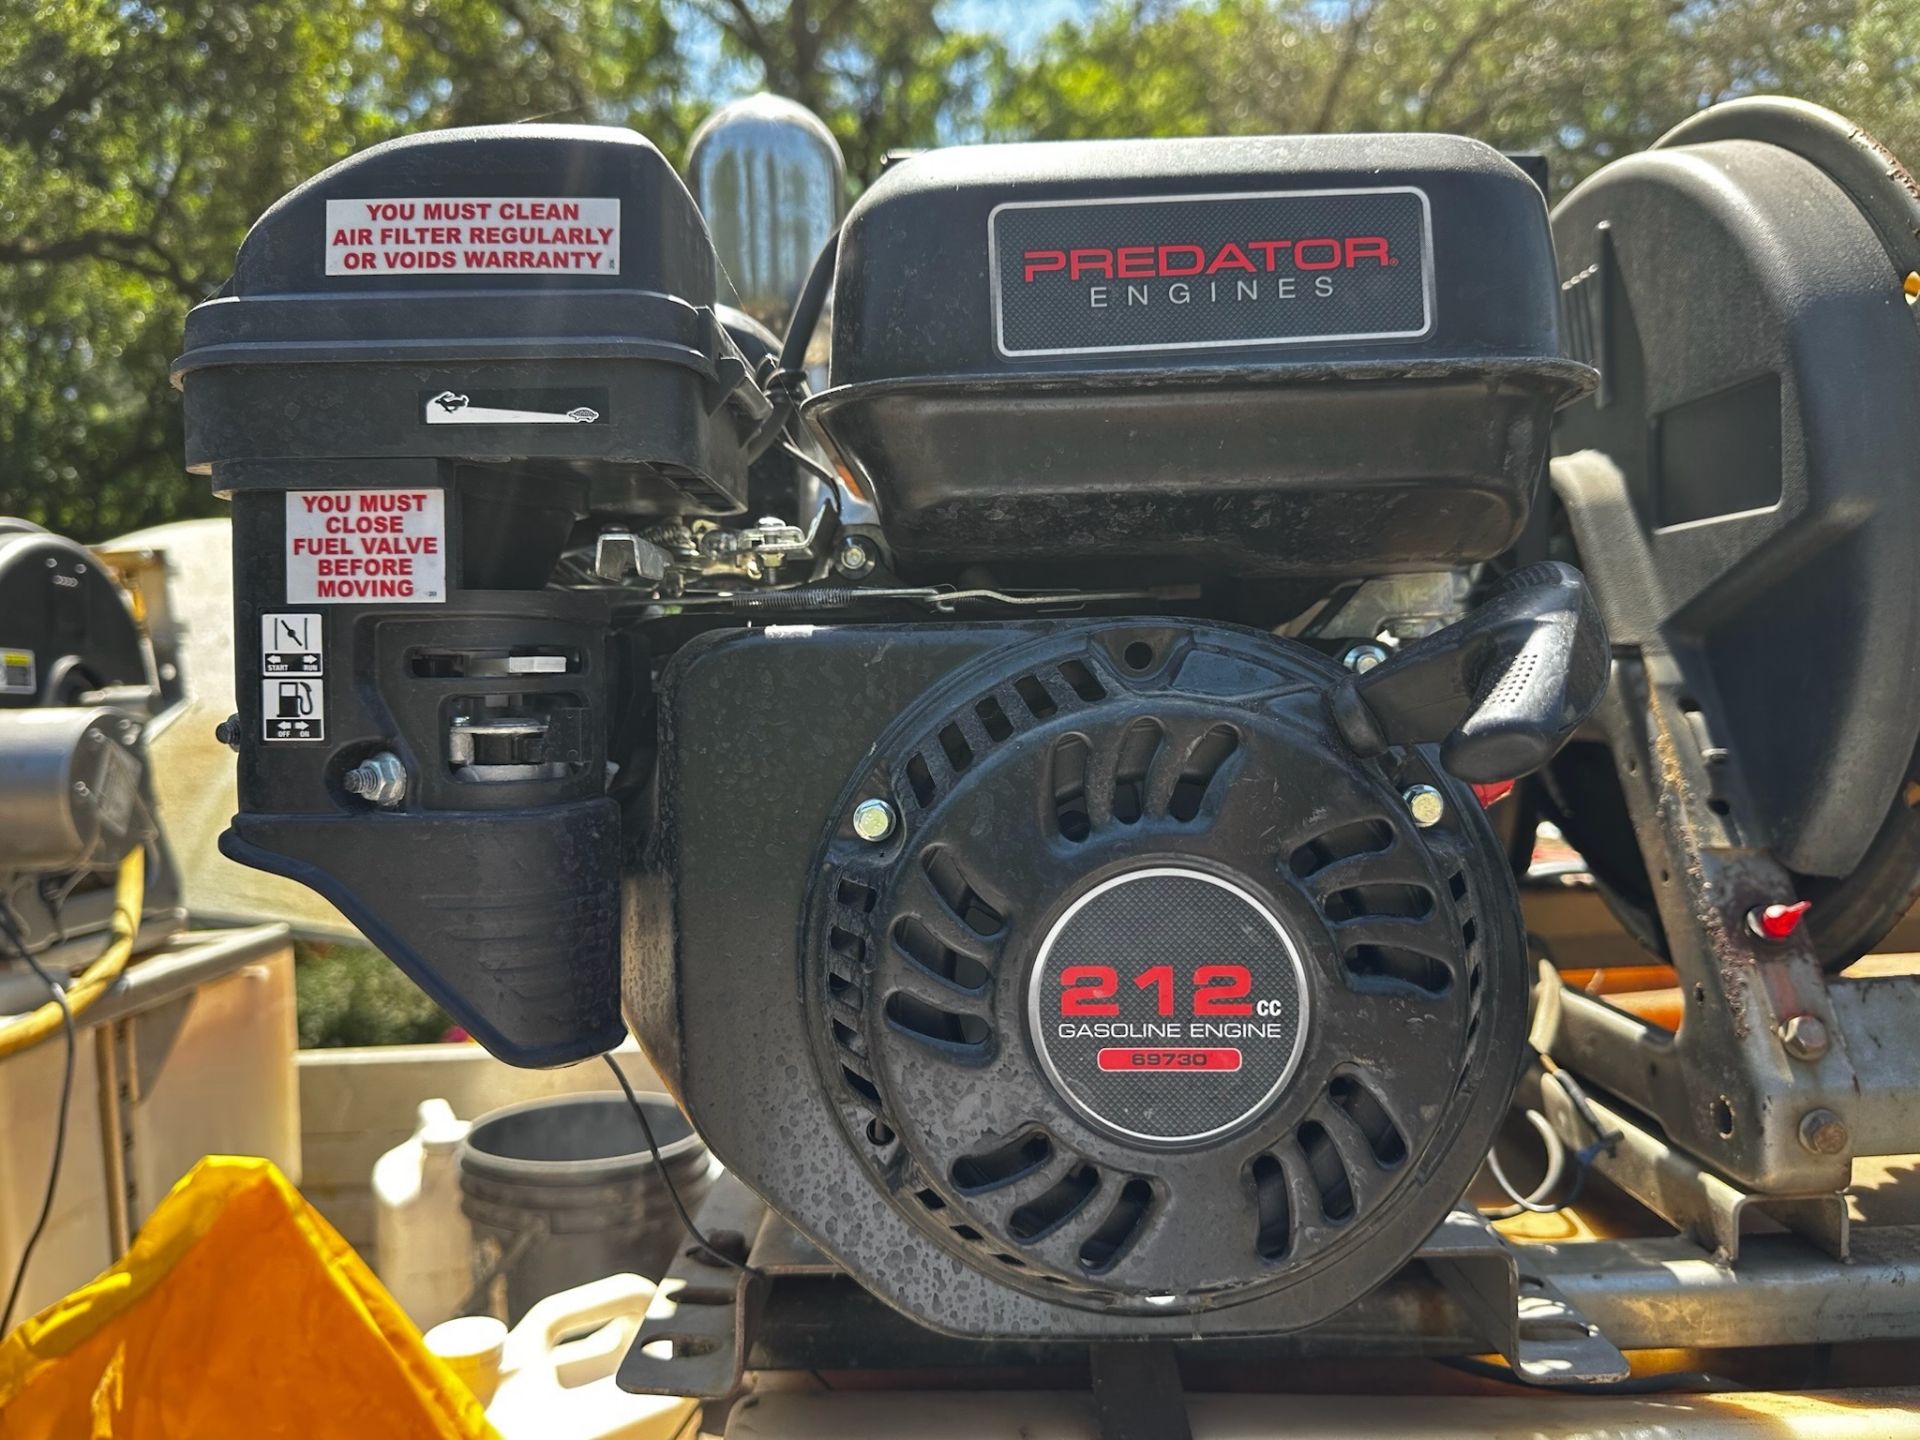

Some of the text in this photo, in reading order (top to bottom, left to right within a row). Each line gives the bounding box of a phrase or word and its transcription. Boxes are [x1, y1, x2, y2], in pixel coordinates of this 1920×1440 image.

[366, 203, 579, 221] YOU MUST CLEAN
[332, 227, 614, 246] AIR FILTER REGULARLY
[343, 252, 377, 270] OR
[383, 251, 457, 269] VOIDS
[464, 251, 603, 269] WARRANTY
[1089, 276, 1335, 308] ENGINES
[302, 494, 427, 513] YOU MUST
[325, 516, 404, 534] CLOSE
[293, 537, 438, 555] FUEL VALVE
[318, 558, 413, 576] BEFORE
[317, 579, 414, 597] MOVING
[1058, 963, 1253, 1017] 212
[1058, 1022, 1282, 1039] GASOLINE ENGINE
[1130, 1053, 1208, 1067] 69730
